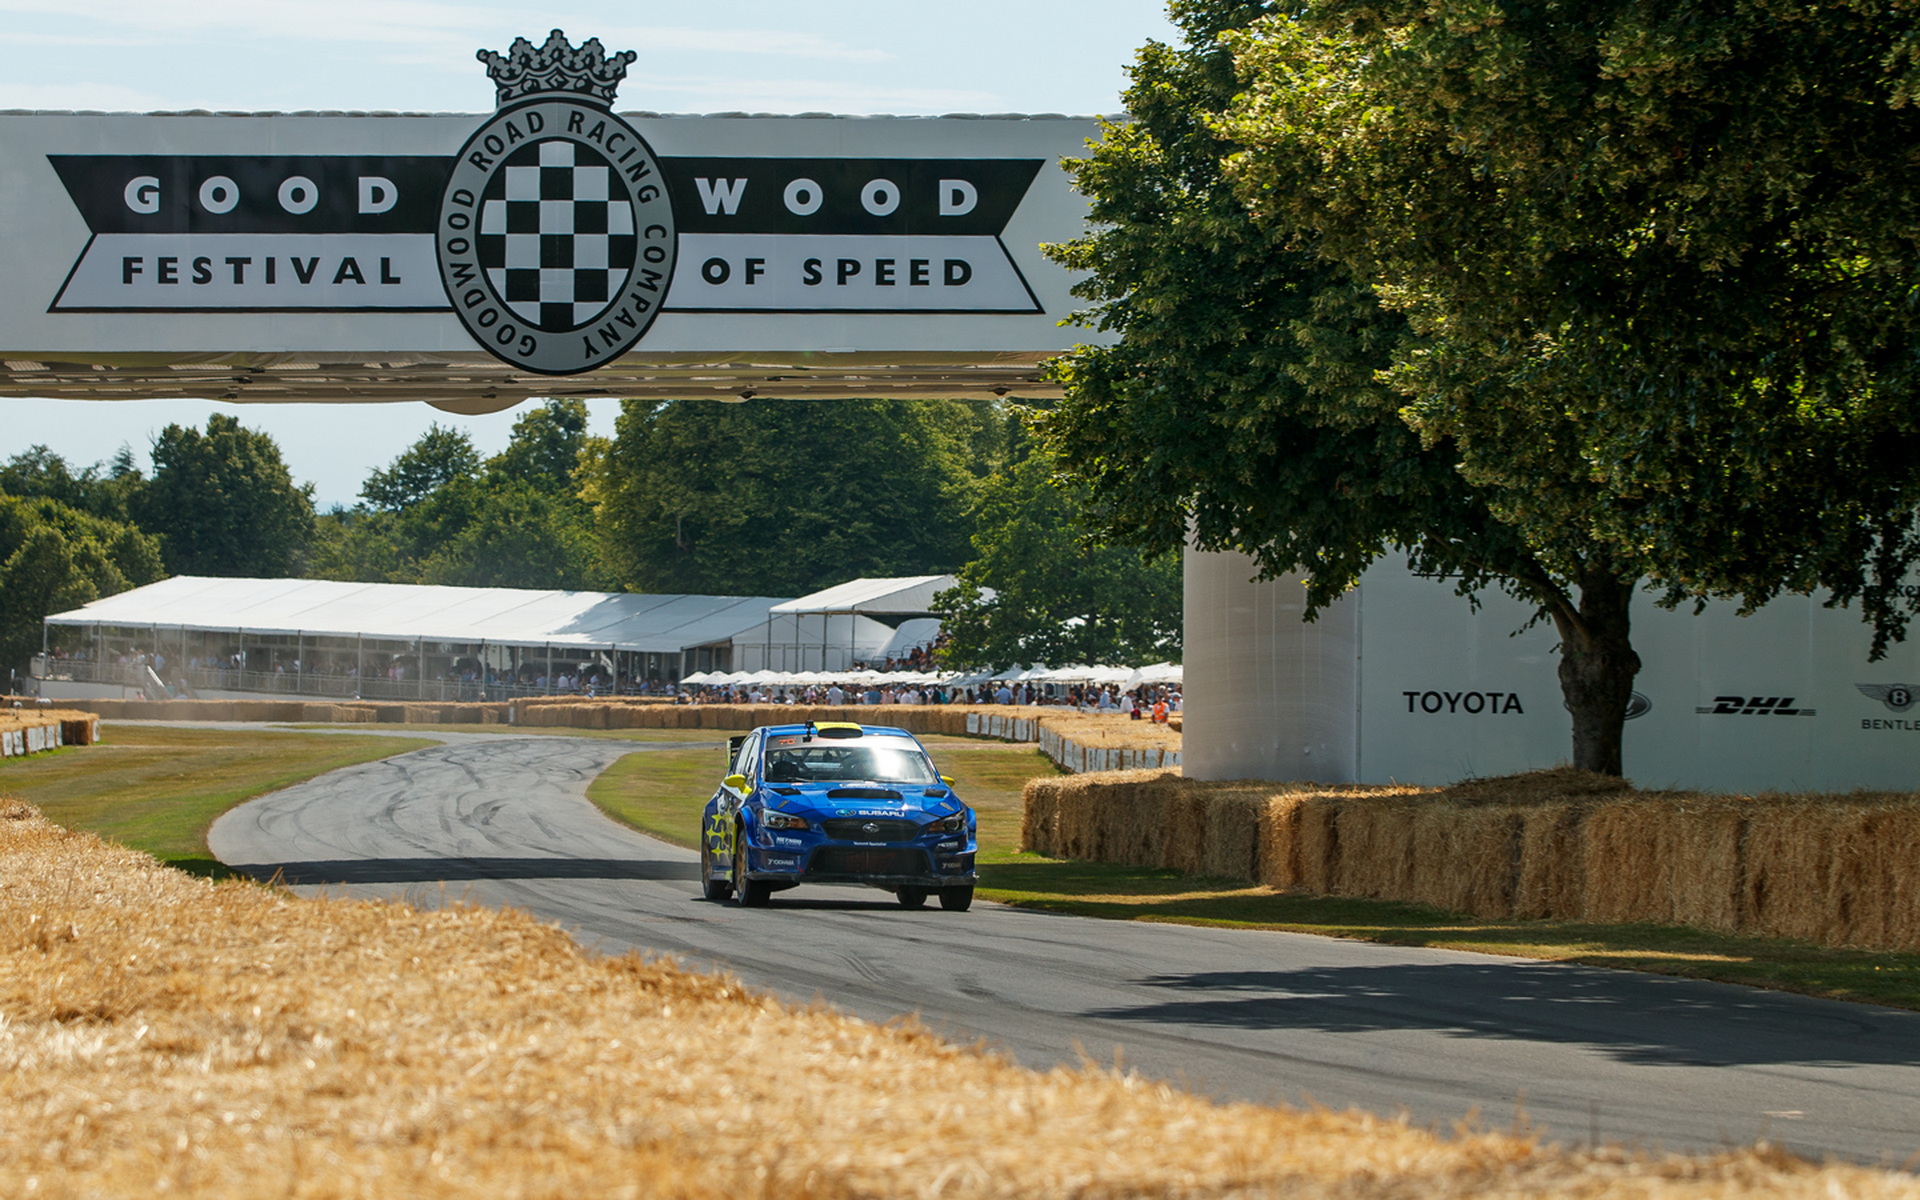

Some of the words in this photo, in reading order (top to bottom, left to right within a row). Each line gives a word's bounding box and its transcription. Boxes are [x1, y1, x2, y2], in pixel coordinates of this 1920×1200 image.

[468, 110, 545, 173] ROAD
[567, 110, 660, 204] RACING
[123, 175, 399, 215] GOOD
[694, 177, 978, 217] WOOD
[122, 256, 402, 285] FESTIVAL
[701, 257, 766, 285] OF
[803, 257, 973, 286] SPEED
[447, 188, 537, 357] GOODWOOD
[581, 224, 667, 359] COMPANY
[1402, 690, 1524, 715] TOYOTA
[1712, 696, 1800, 716] DHL
[858, 810, 905, 818] SUBARU
